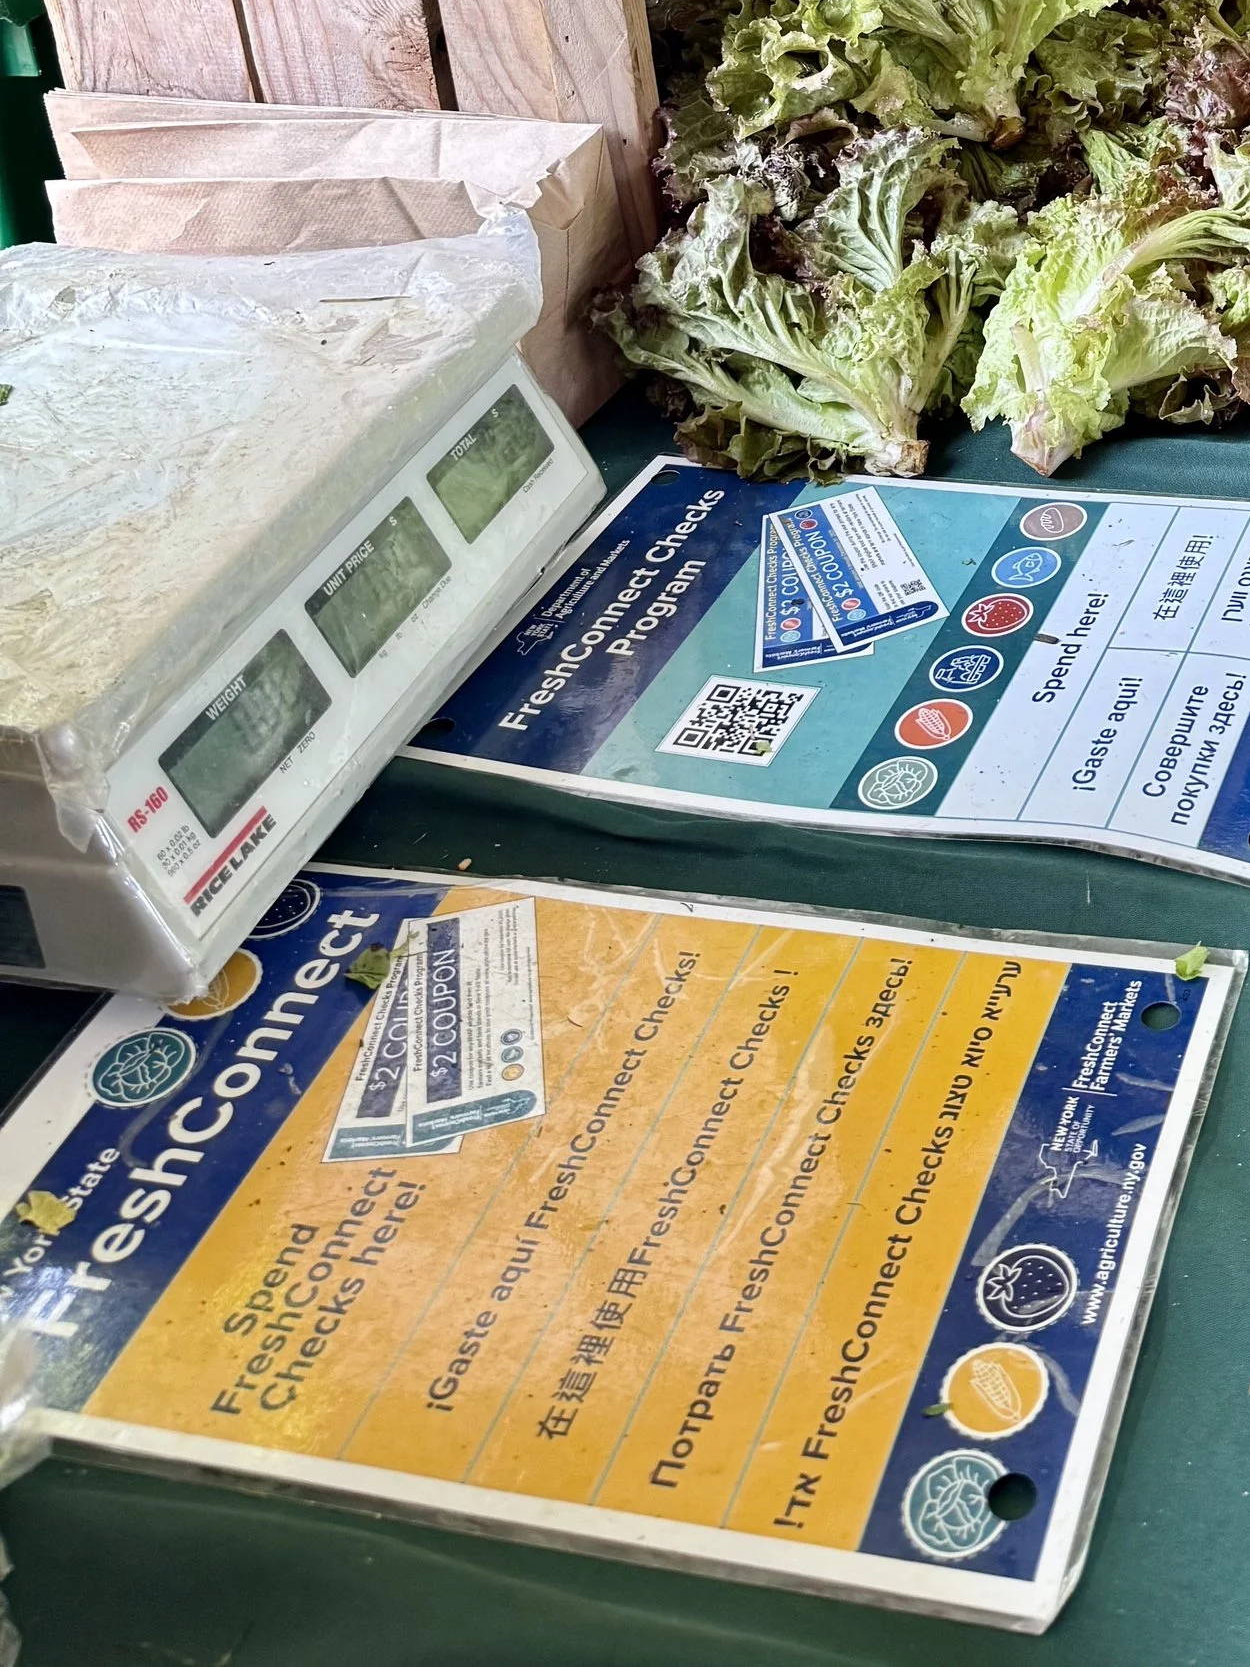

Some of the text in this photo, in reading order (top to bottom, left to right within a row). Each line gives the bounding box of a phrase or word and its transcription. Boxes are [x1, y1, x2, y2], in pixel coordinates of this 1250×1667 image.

[450, 434, 477, 461] TOTAL
[323, 567, 346, 596] UNIT
[345, 540, 375, 574] PRICE
[555, 539, 630, 619] Agriculture and Markets
[766, 555, 777, 584] Checks
[797, 547, 818, 573] Checks
[805, 531, 844, 577] COUPON
[421, 586, 442, 609] Change
[498, 487, 725, 732] FreshConnect Checks
[541, 576, 583, 617] Department
[606, 558, 707, 658] Program
[764, 584, 776, 640] FreshConnect
[811, 573, 843, 622] FreshConnect
[832, 581, 853, 599] $2
[1032, 591, 1109, 704] Spend here!
[205, 674, 248, 722] WEIGHT
[279, 731, 316, 774] NET ZERO
[1072, 727, 1117, 791] ¡Gaste
[1142, 685, 1209, 798] Совершите
[1171, 672, 1247, 825] покупки здесь!
[127, 786, 169, 833] RS-160
[190, 814, 277, 917] RICE LAKE
[414, 986, 423, 1015] Checks
[429, 947, 457, 1078] $2 COUPON
[355, 1022, 380, 1081] FreshConnect
[374, 990, 391, 1023] Checks
[413, 1015, 423, 1072] FreshConnect
[1072, 1001, 1118, 1089] FreshConnect
[1090, 980, 1142, 1091] Farmers' Markets
[369, 1067, 398, 1091] $2
[32, 908, 380, 1337] FreshConnect
[1051, 1096, 1080, 1151] NEW YORK
[1064, 1131, 1078, 1152] STATE
[1073, 1104, 1095, 1153] OPPORTUNITY
[425, 950, 701, 1413] ¡Gaste aquí FreshConnect Checks!
[650, 957, 913, 1488] Потрать FreshConnect Checks здесь!
[1081, 1142, 1147, 1325] www.agriculture.ny.gov
[210, 1165, 397, 1415] FreshConnect
[223, 1223, 320, 1337] Spend
[260, 1276, 365, 1411] Checks
[350, 1180, 427, 1266] here!
[802, 1233, 912, 1460] FreshConnect
[895, 1125, 954, 1225] Checks
